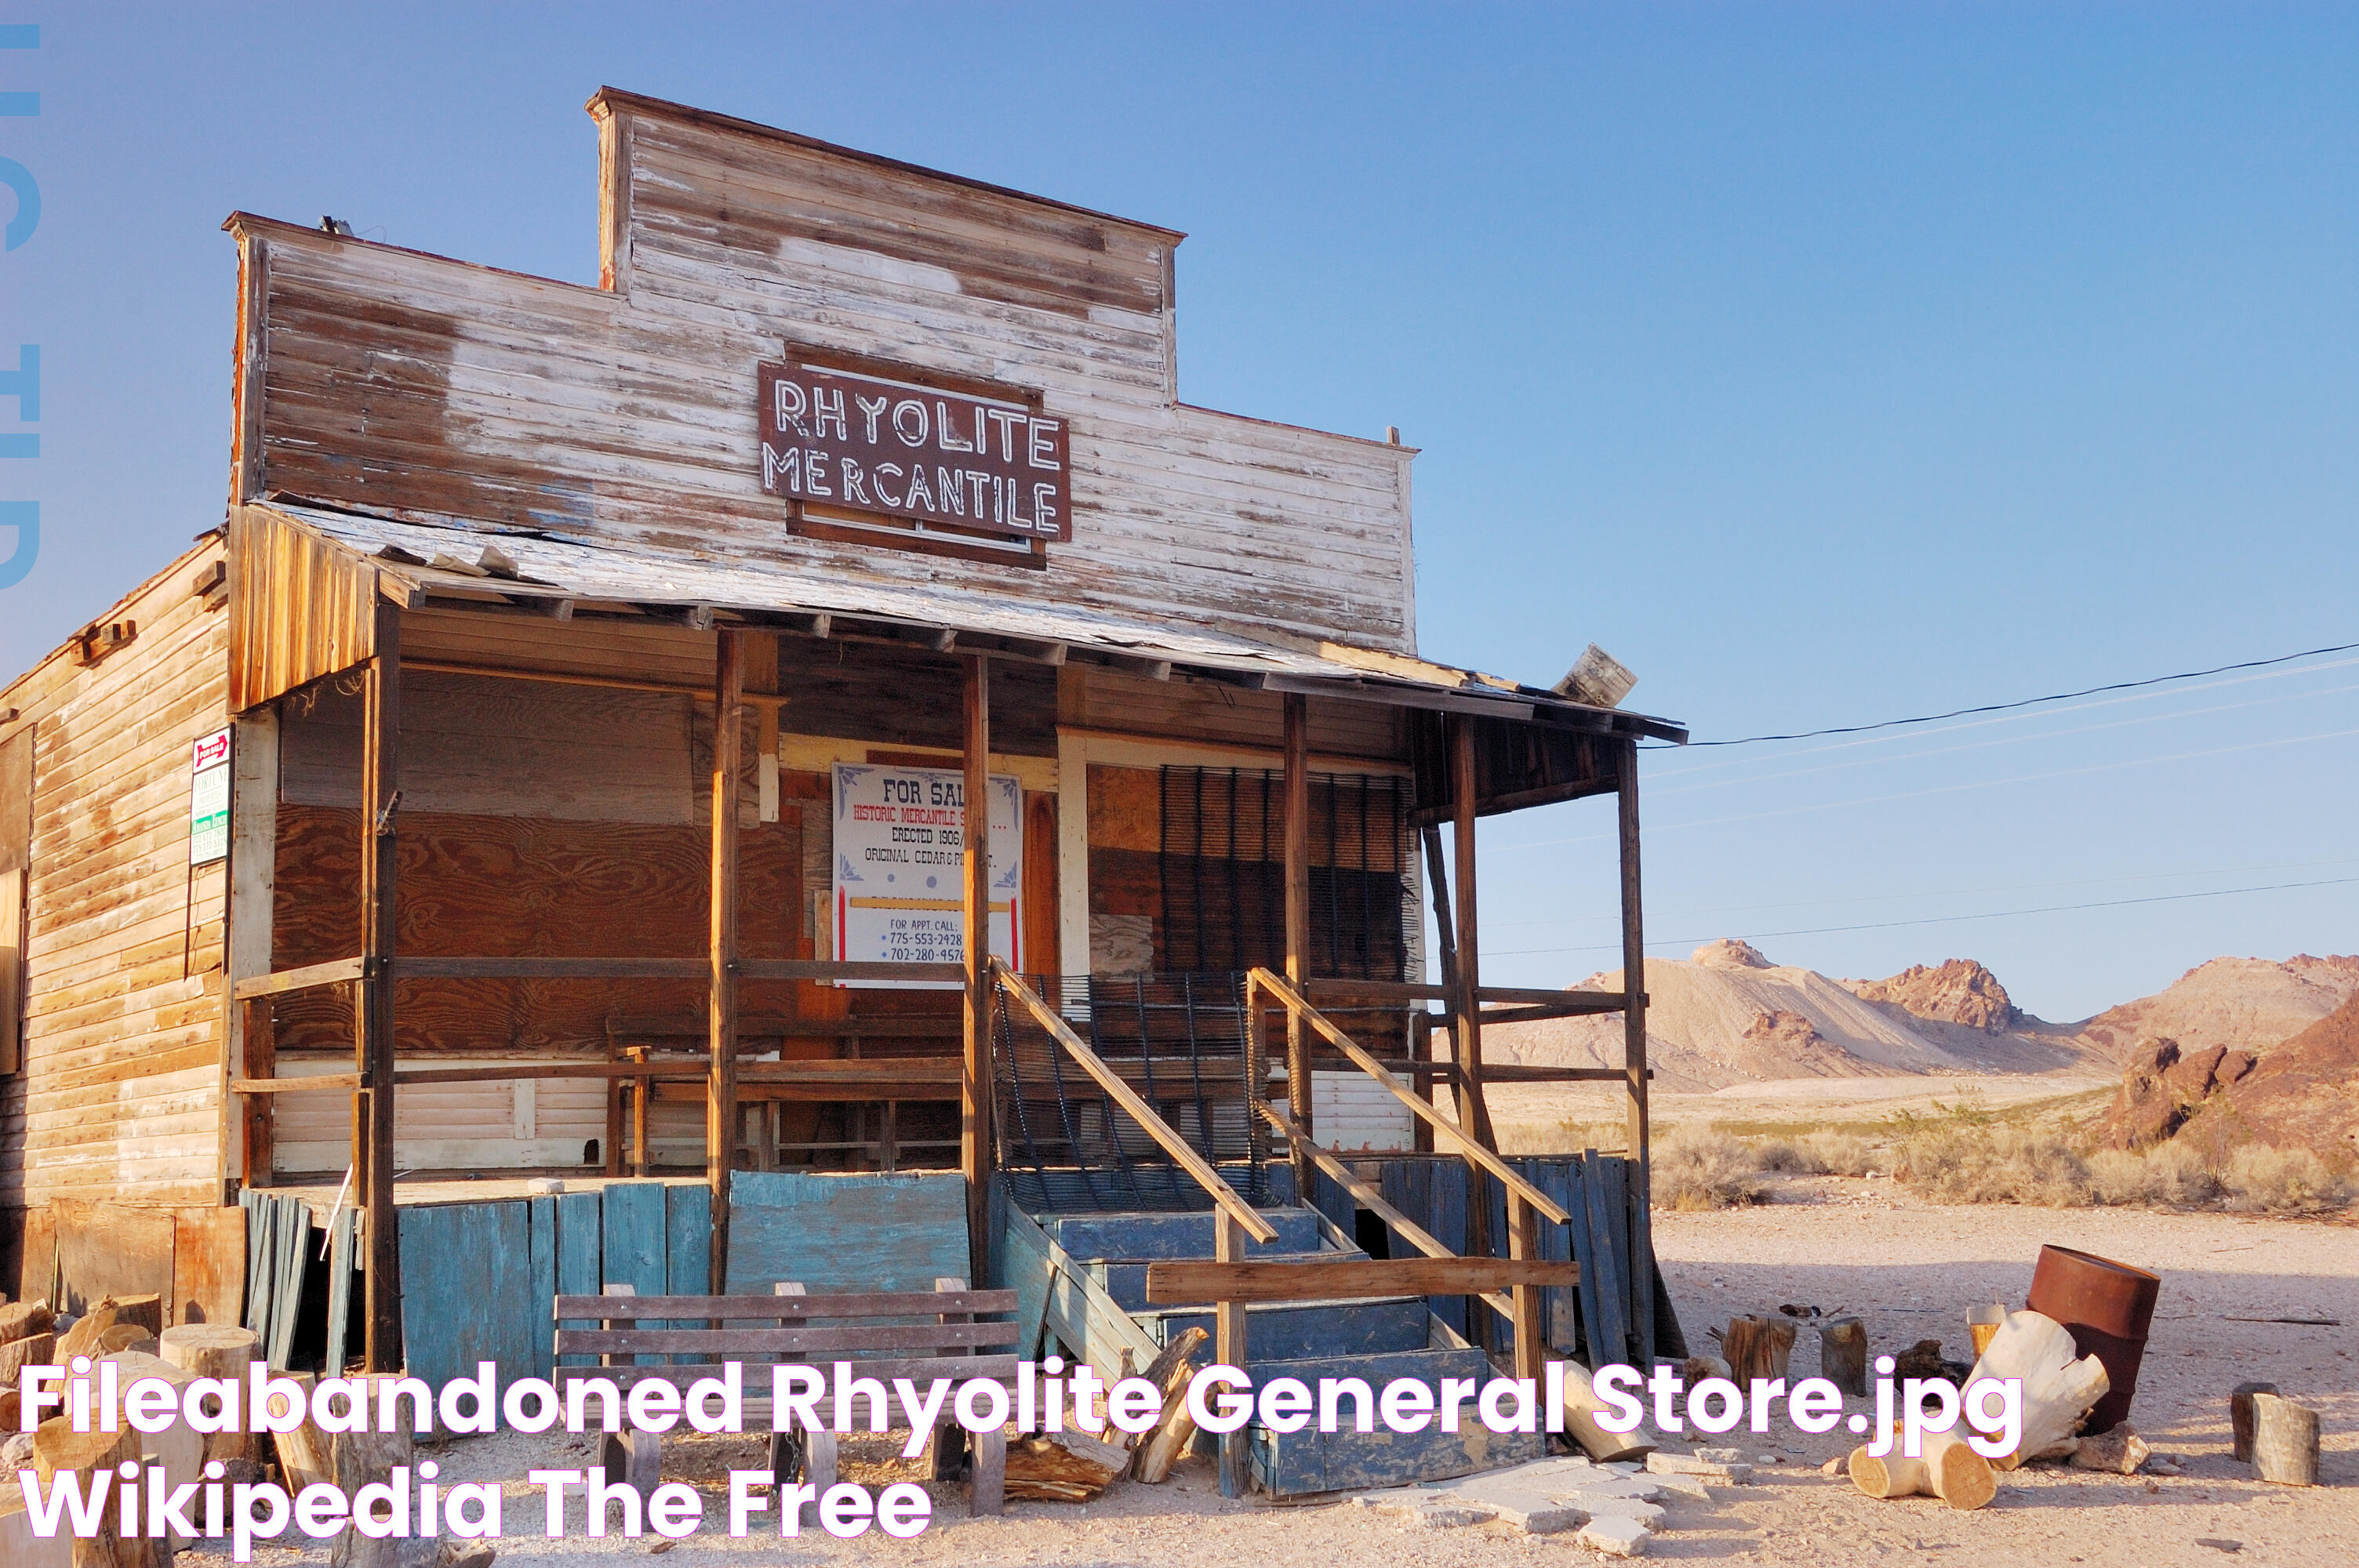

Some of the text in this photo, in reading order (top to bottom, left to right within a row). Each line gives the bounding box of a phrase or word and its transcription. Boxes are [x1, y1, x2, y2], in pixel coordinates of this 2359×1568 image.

[775, 379, 1060, 470] RHYOLITE
[761, 442, 1060, 533] MERCANTILE
[199, 742, 224, 760] FOR SALE
[883, 779, 965, 807] FOR SAL
[853, 804, 896, 822] HISTORIC
[902, 808, 956, 826] MERCANTILE
[892, 826, 965, 847] ERECTED 1906/
[865, 848, 910, 863] ORIGINAL
[890, 919, 907, 930] FOR
[911, 920, 933, 931] APPT.
[890, 932, 962, 946] 775-553-2428
